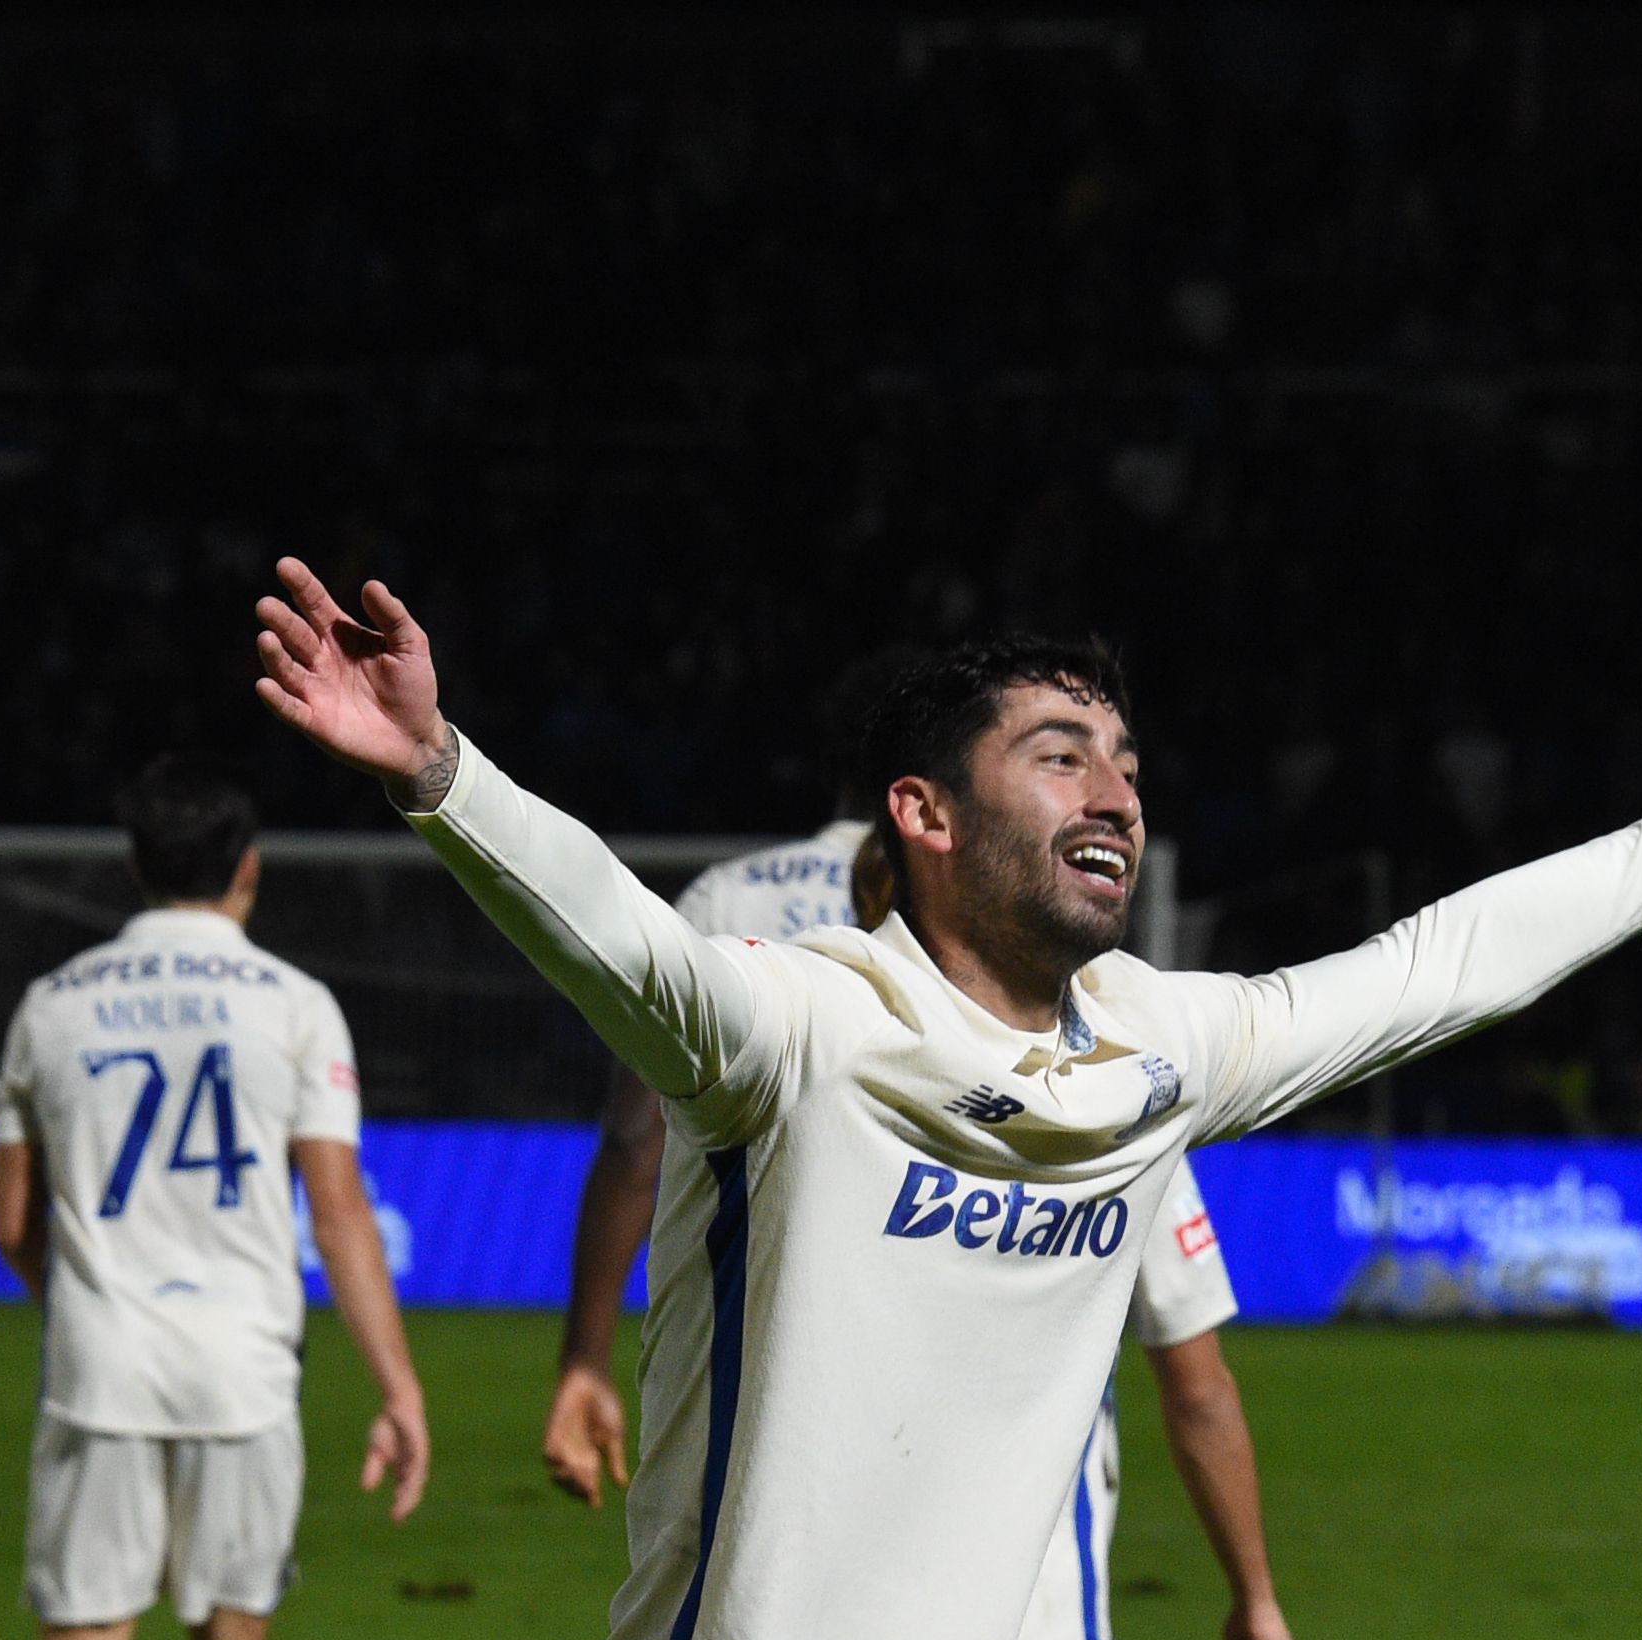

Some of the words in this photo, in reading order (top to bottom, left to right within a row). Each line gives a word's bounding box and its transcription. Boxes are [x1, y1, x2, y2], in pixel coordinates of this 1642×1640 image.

[746, 856, 853, 887] SUPE
[49, 952, 162, 991] SUPER
[172, 951, 281, 987] BOCK
[94, 993, 230, 1031] MOURA
[81, 1041, 260, 1220] 74
[882, 1159, 1130, 1259] Betano
